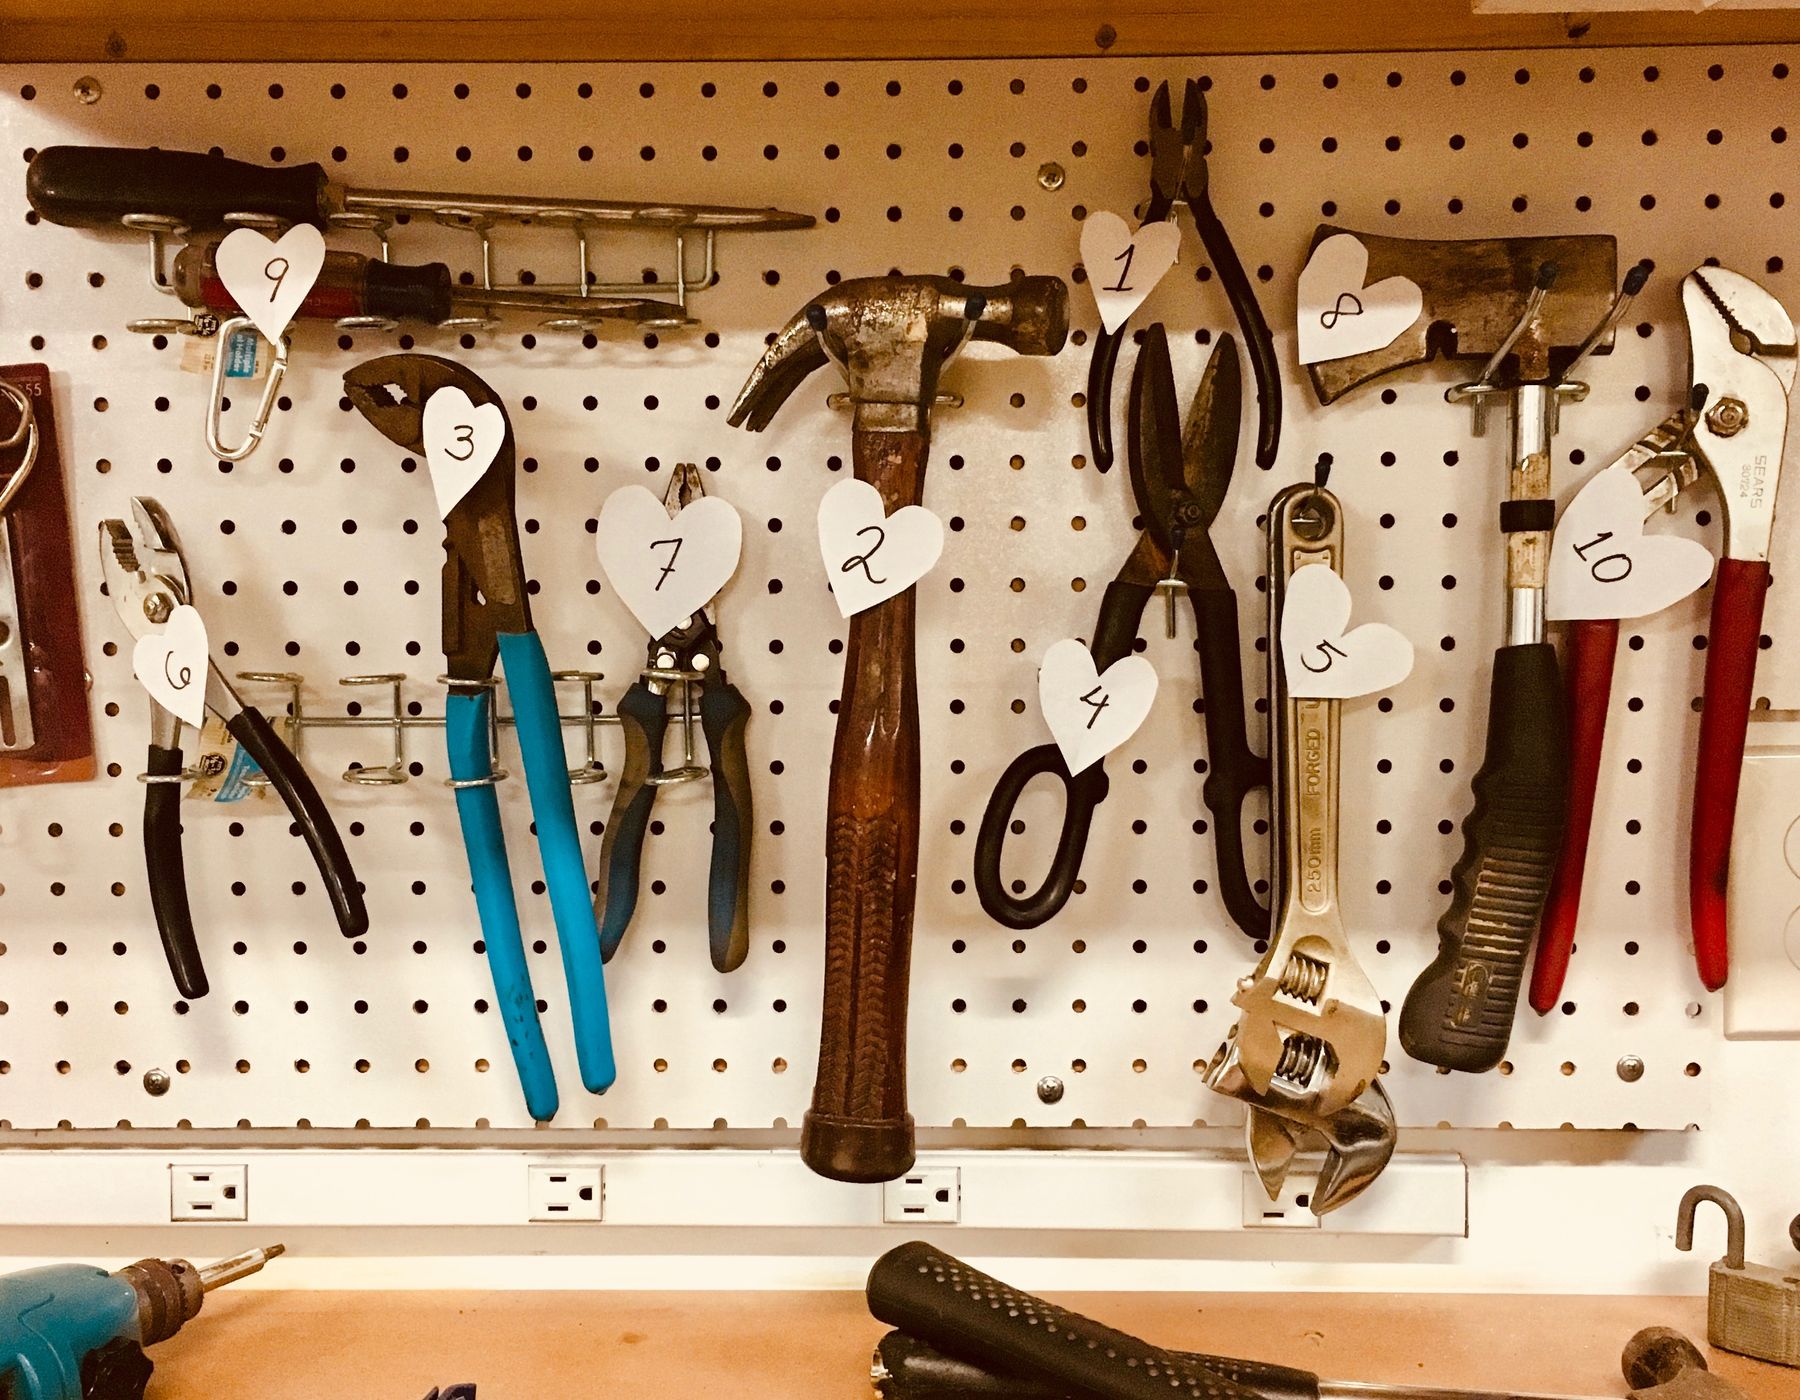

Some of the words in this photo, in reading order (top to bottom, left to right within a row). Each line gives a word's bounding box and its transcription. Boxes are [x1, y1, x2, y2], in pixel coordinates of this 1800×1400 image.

[264, 257, 289, 303] 9
[1102, 244, 1135, 292] 1
[1321, 292, 1364, 330] 8
[445, 425, 474, 461] 3
[1750, 455, 1768, 509] SEARS
[650, 538, 682, 591] 7
[842, 526, 886, 584] 2
[1573, 532, 1632, 583] 10
[165, 650, 190, 690] 6
[1301, 640, 1347, 673] 5
[1080, 686, 1109, 729] 4
[1305, 728, 1321, 796] FORGED
